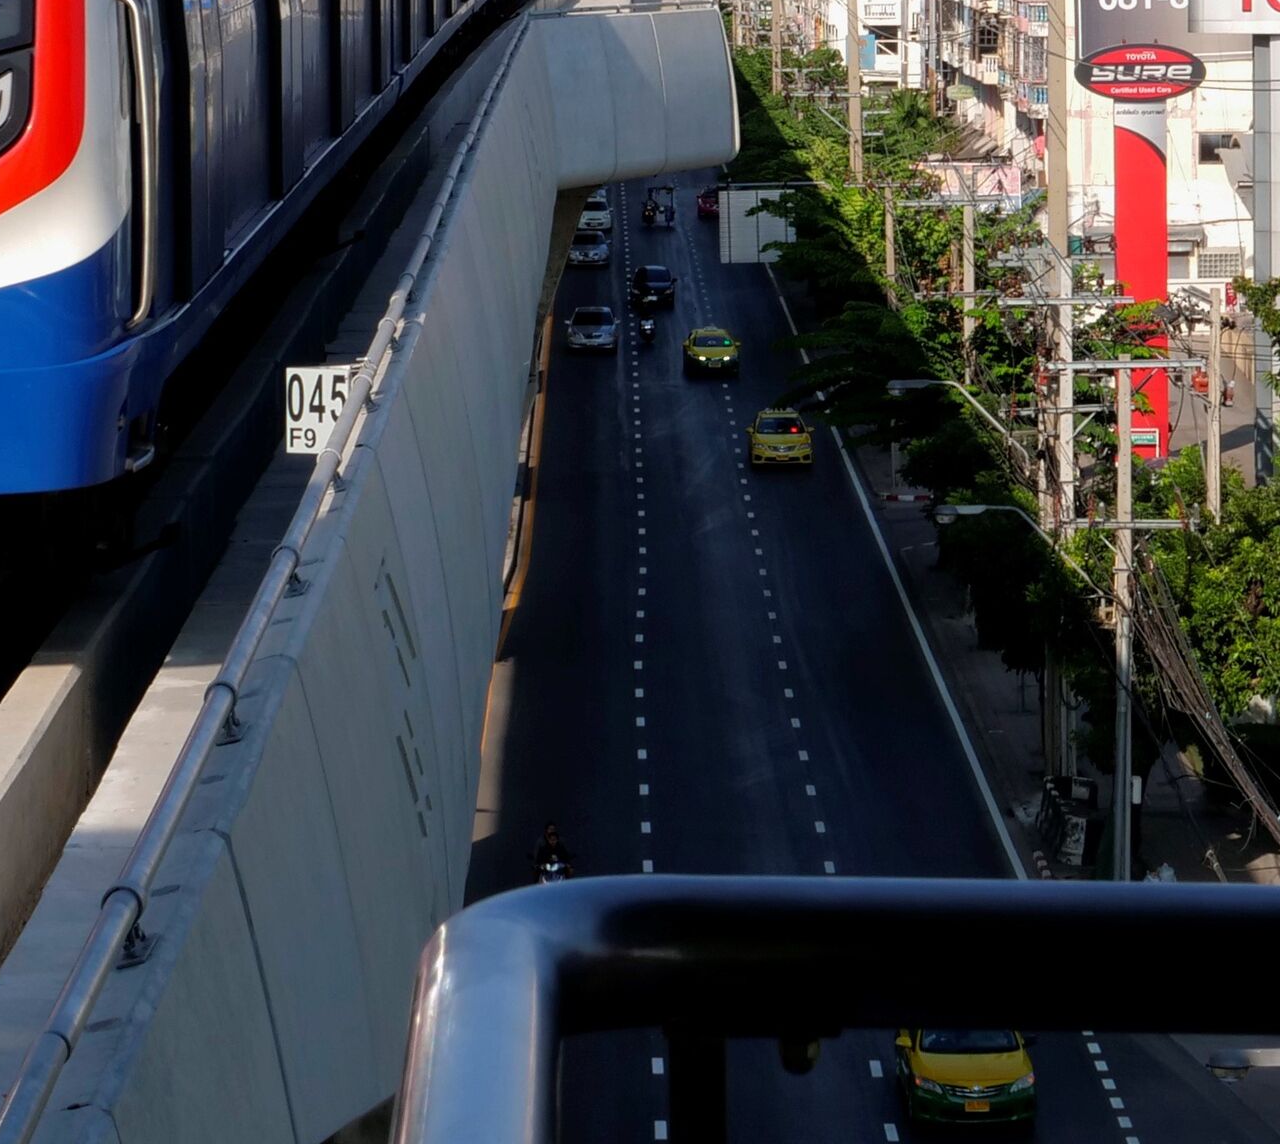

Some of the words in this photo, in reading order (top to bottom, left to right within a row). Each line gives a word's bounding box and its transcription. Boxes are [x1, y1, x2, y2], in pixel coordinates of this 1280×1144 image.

[1125, 52, 1157, 61] TOYOTA
[1110, 86, 1138, 94] Certified
[1138, 86, 1156, 94] Used
[1156, 86, 1172, 94] Cars
[288, 373, 347, 423] 045
[290, 428, 317, 449] F9
